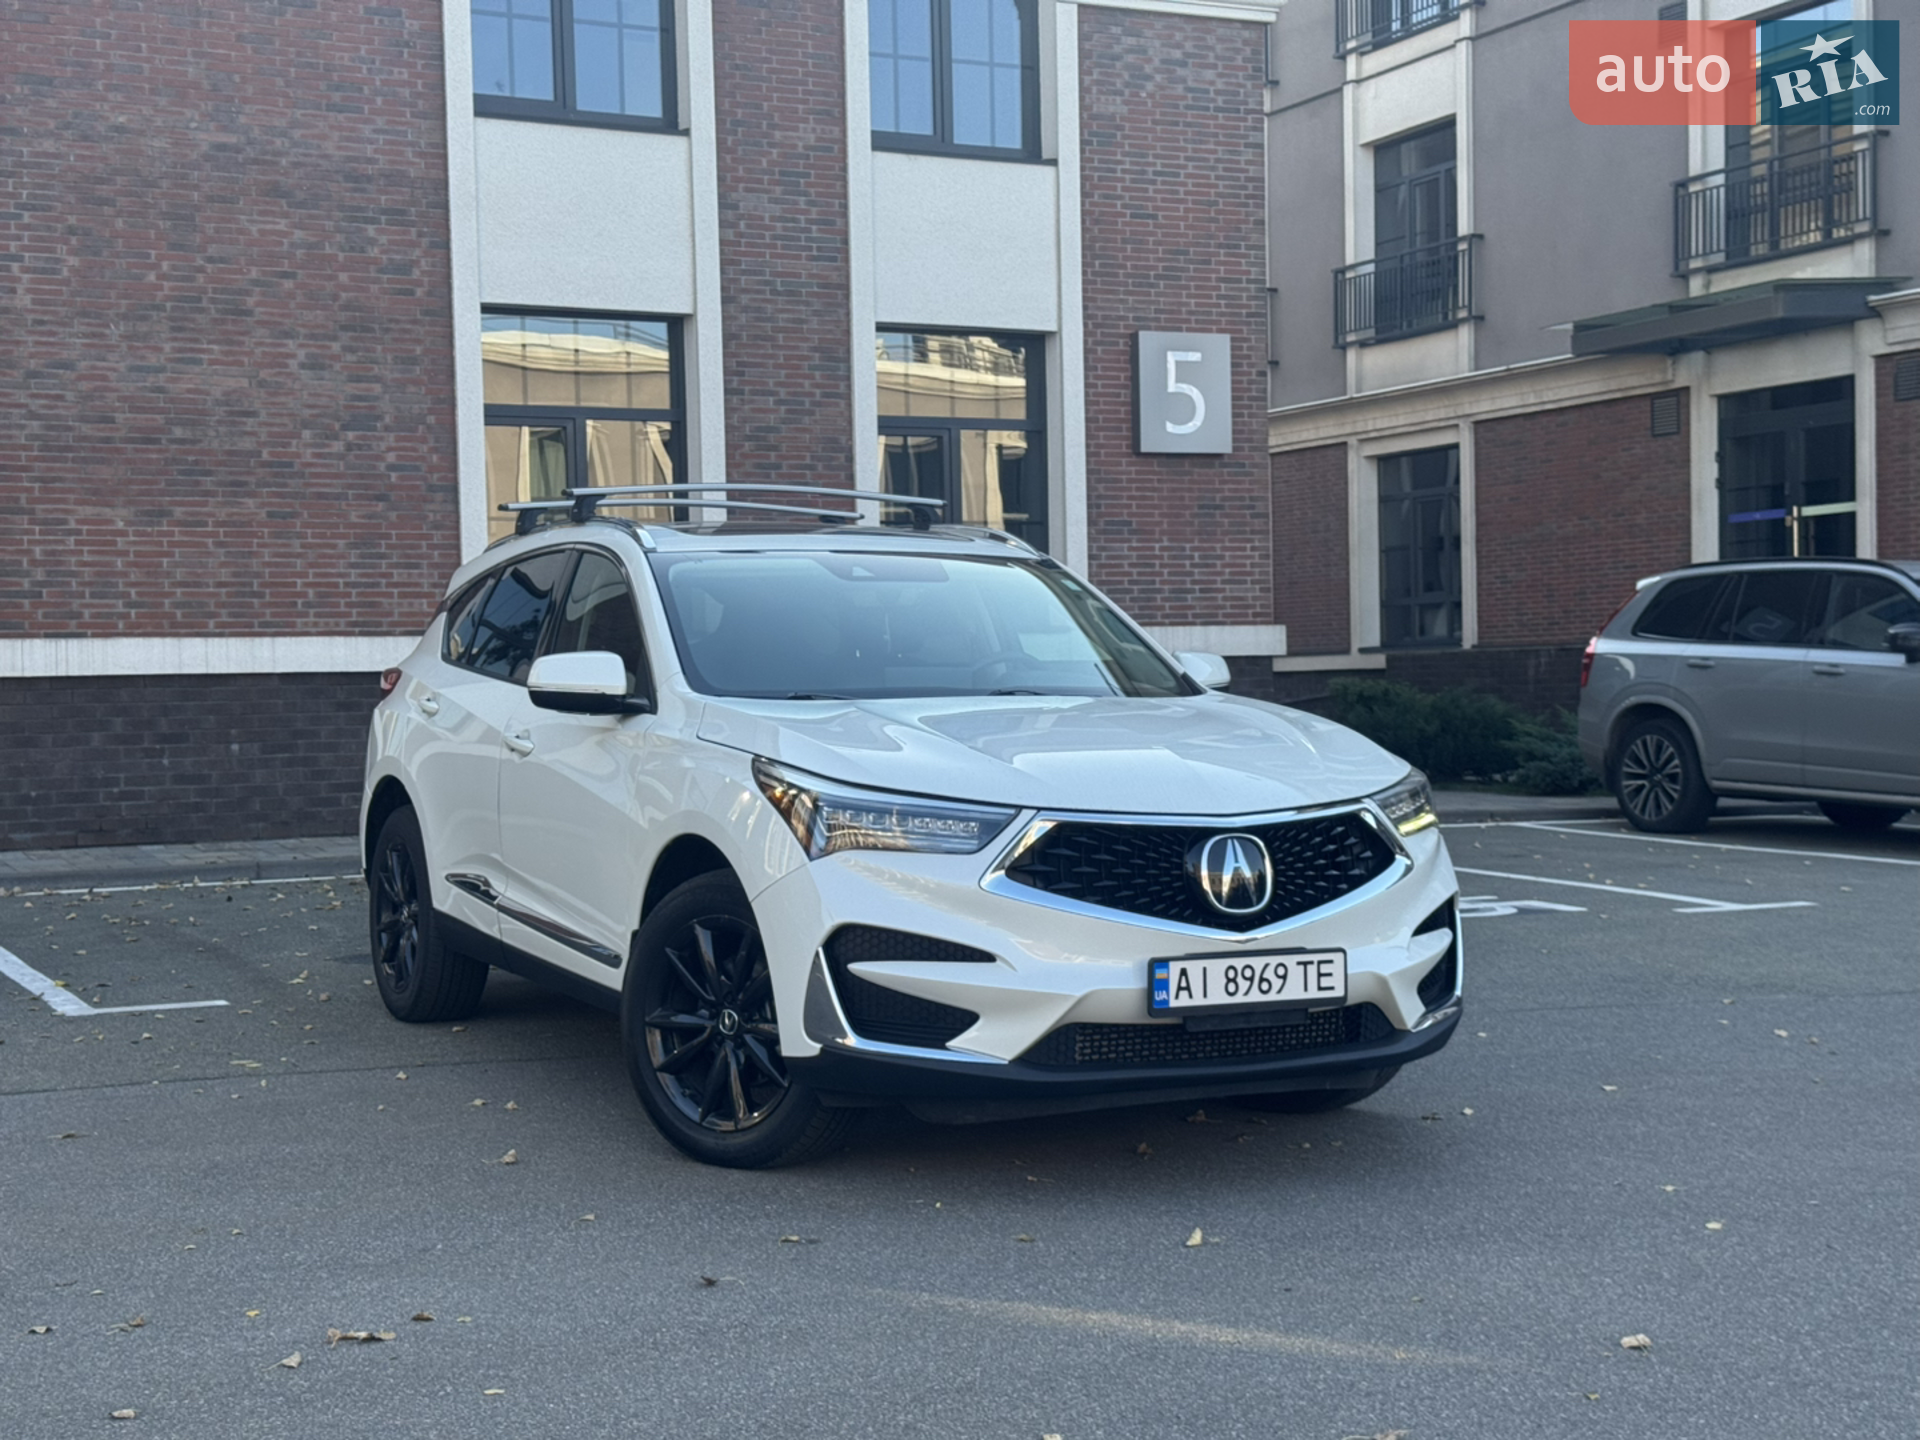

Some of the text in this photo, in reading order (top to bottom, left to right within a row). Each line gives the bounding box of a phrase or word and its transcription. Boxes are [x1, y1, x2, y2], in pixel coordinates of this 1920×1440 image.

[1165, 350, 1206, 435] 5
[1154, 990, 1169, 1001] UA
[1174, 959, 1335, 1000] AI 8969 TE
